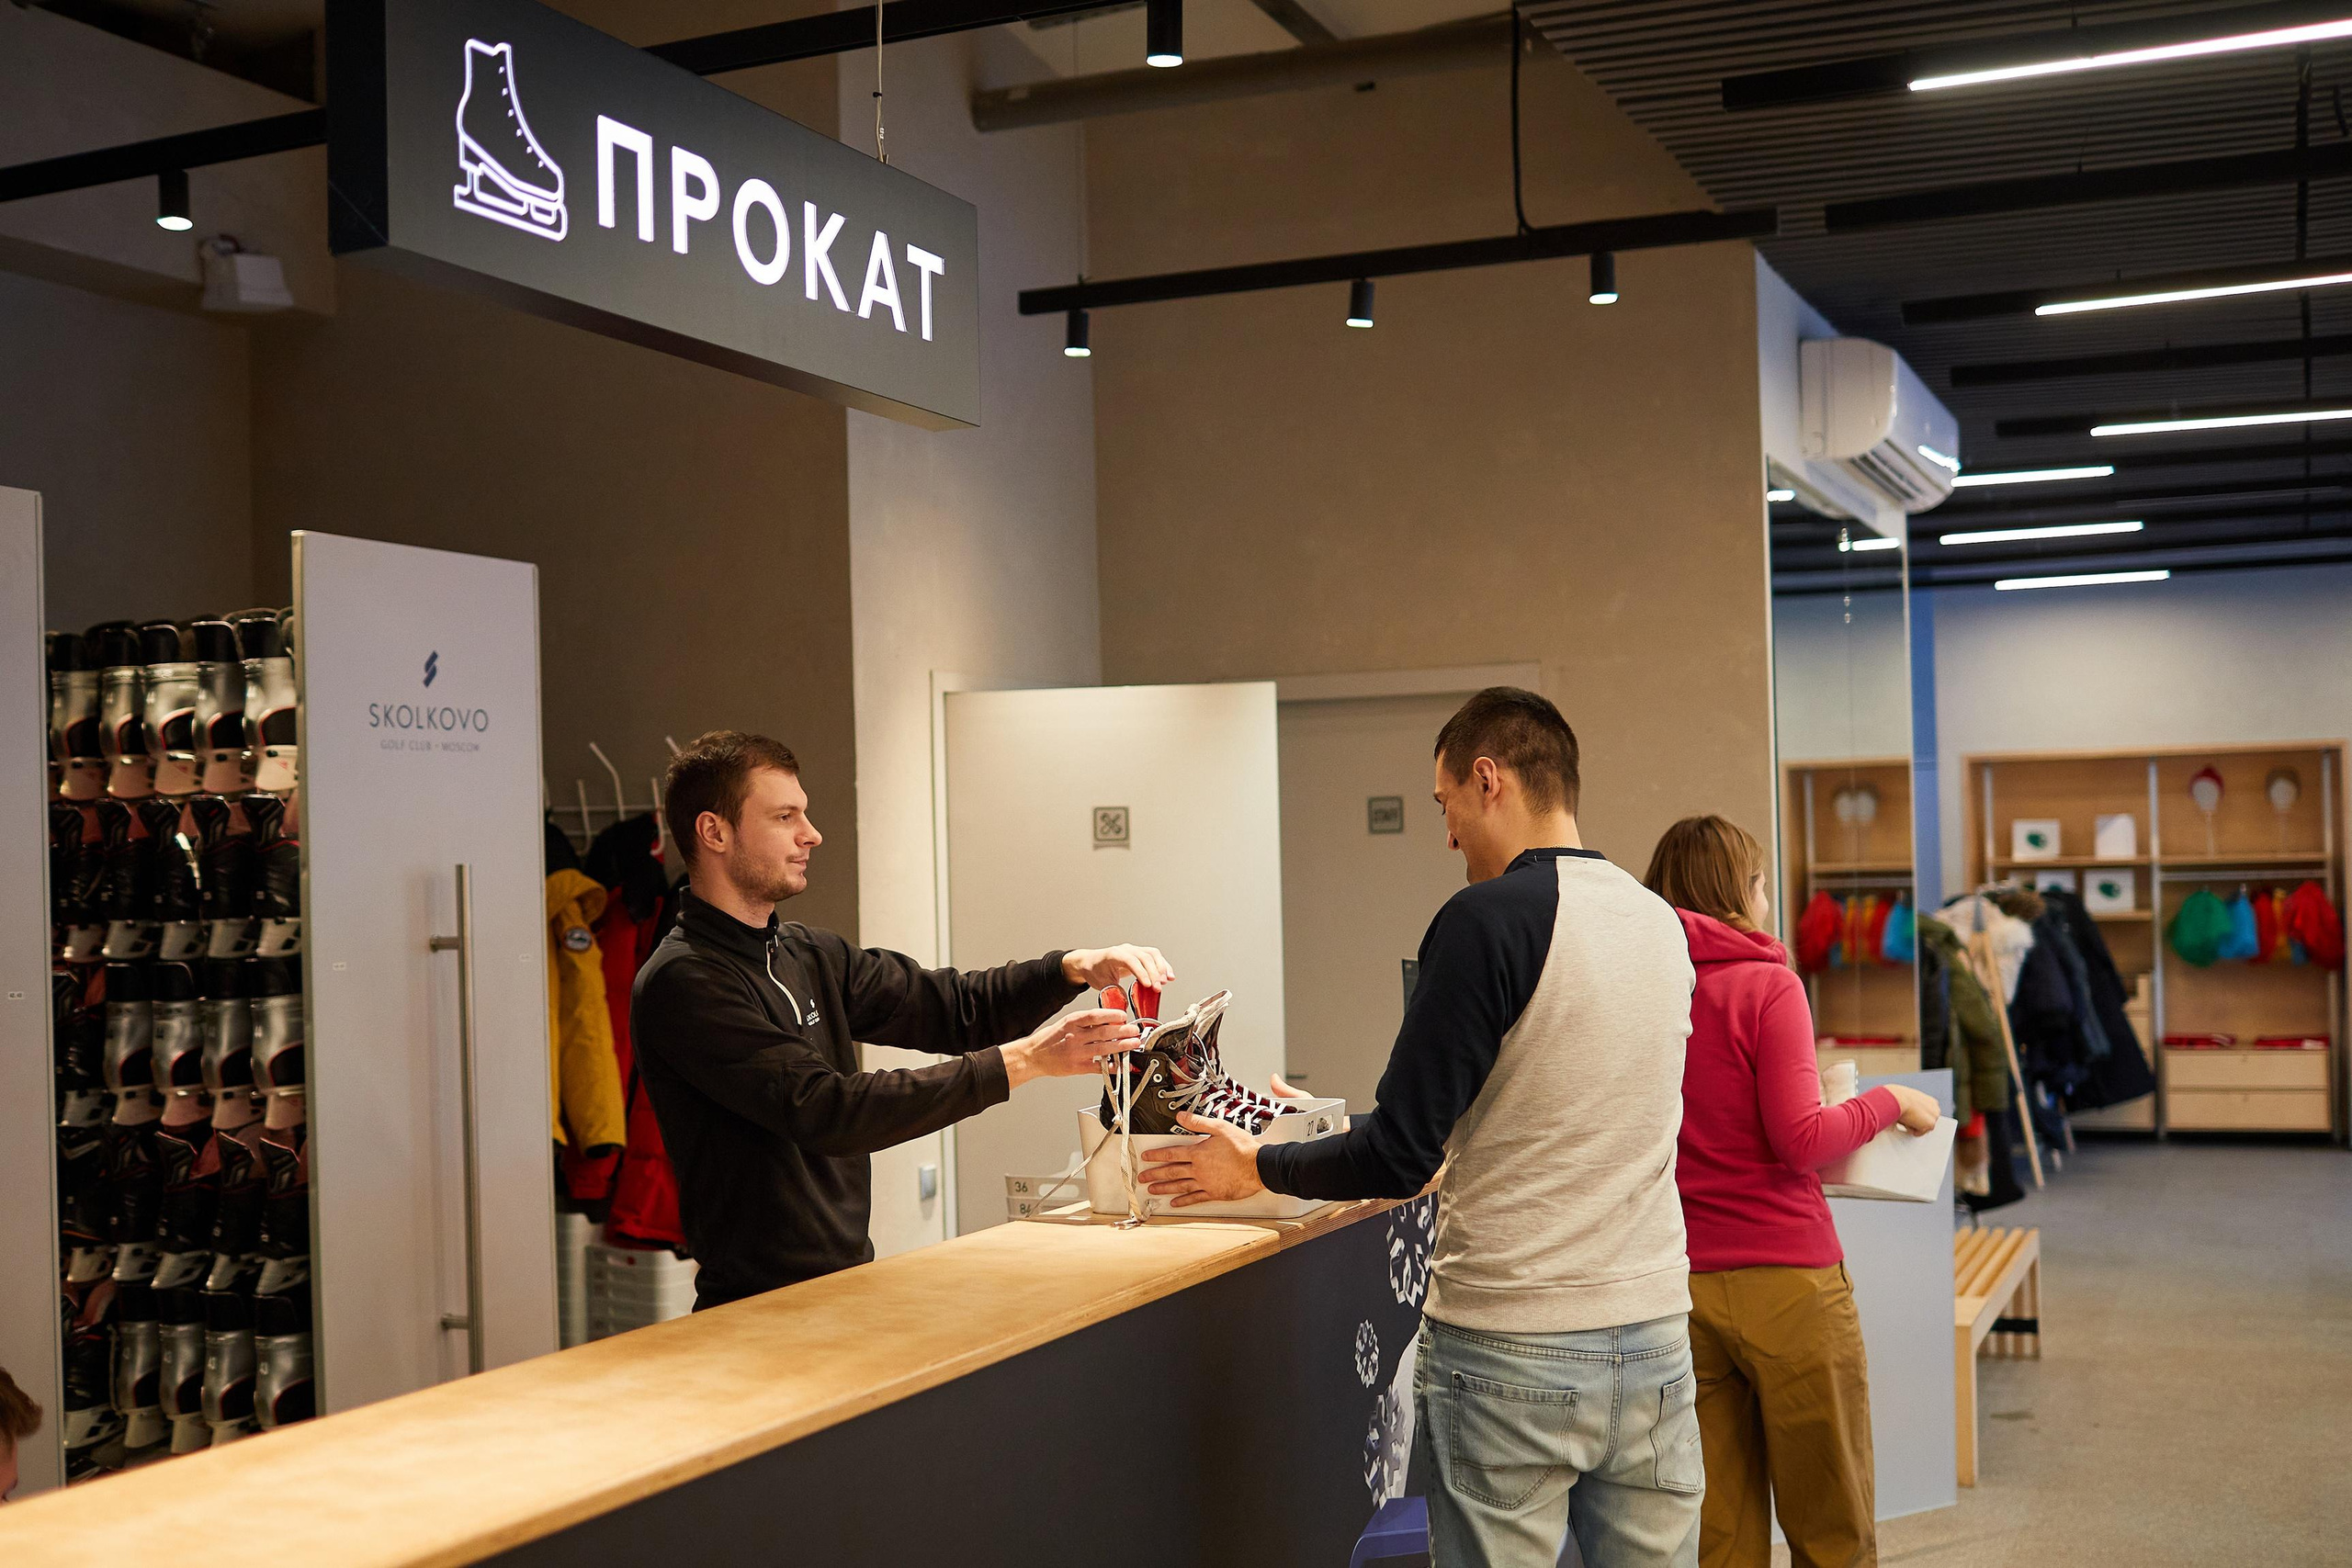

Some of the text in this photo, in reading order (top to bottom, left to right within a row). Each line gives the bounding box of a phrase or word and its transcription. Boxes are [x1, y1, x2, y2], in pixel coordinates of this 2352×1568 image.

[596, 114, 946, 342] ПРОКАТ
[368, 703, 490, 733] SKOLKOVO
[379, 739, 481, 753] GOLF CLUB MOSCOW
[1306, 1120, 1315, 1137] 27
[1014, 1180, 1028, 1193] 36
